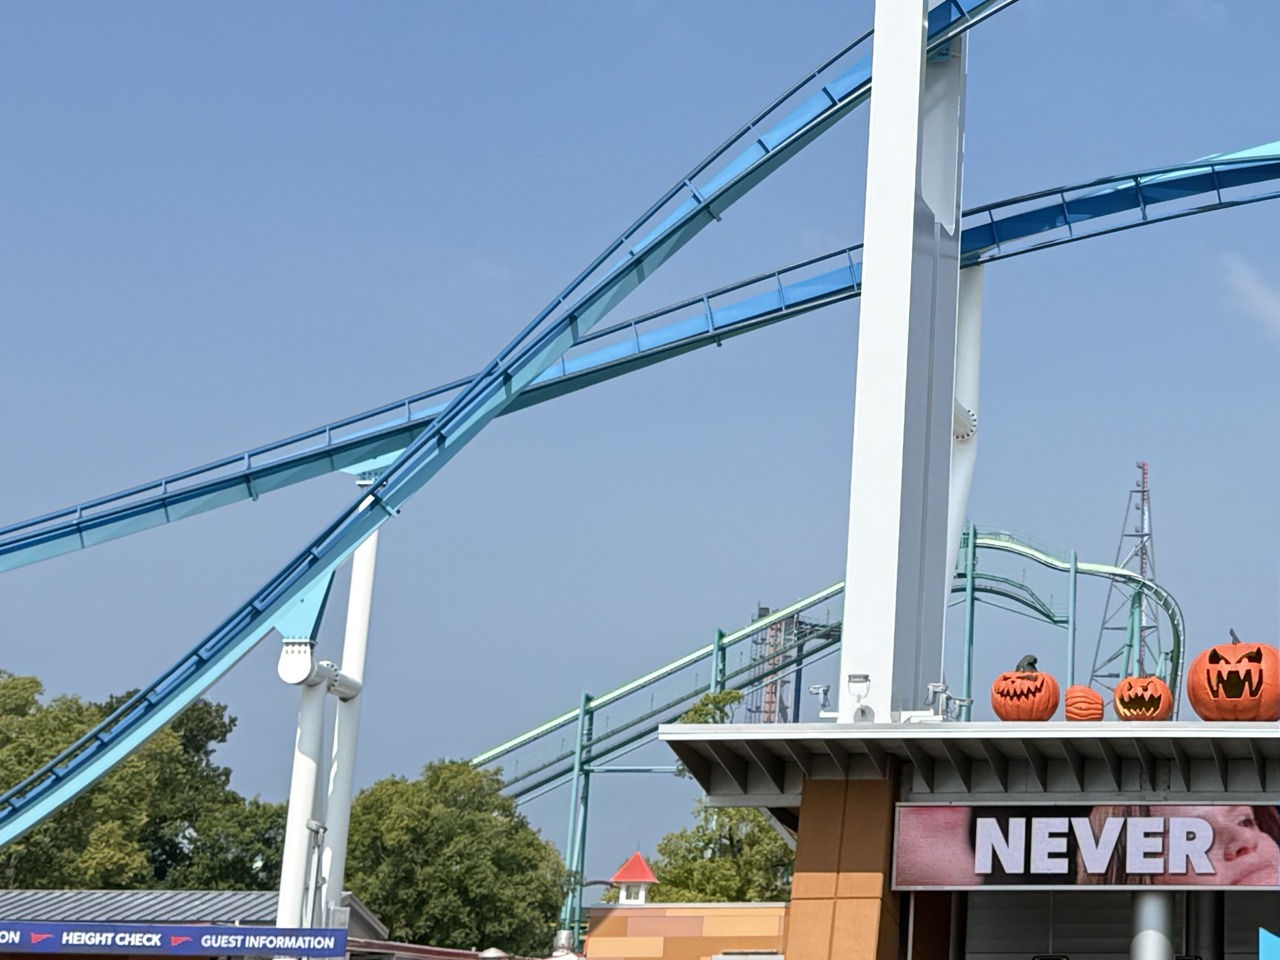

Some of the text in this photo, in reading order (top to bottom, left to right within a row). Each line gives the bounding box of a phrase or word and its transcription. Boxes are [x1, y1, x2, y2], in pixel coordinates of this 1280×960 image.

[974, 817, 1216, 874] NEVER
[61, 931, 114, 945] HEIGHT
[115, 933, 162, 947] CHECK
[201, 934, 244, 948] GUEST
[245, 936, 335, 949] INFORMATION
